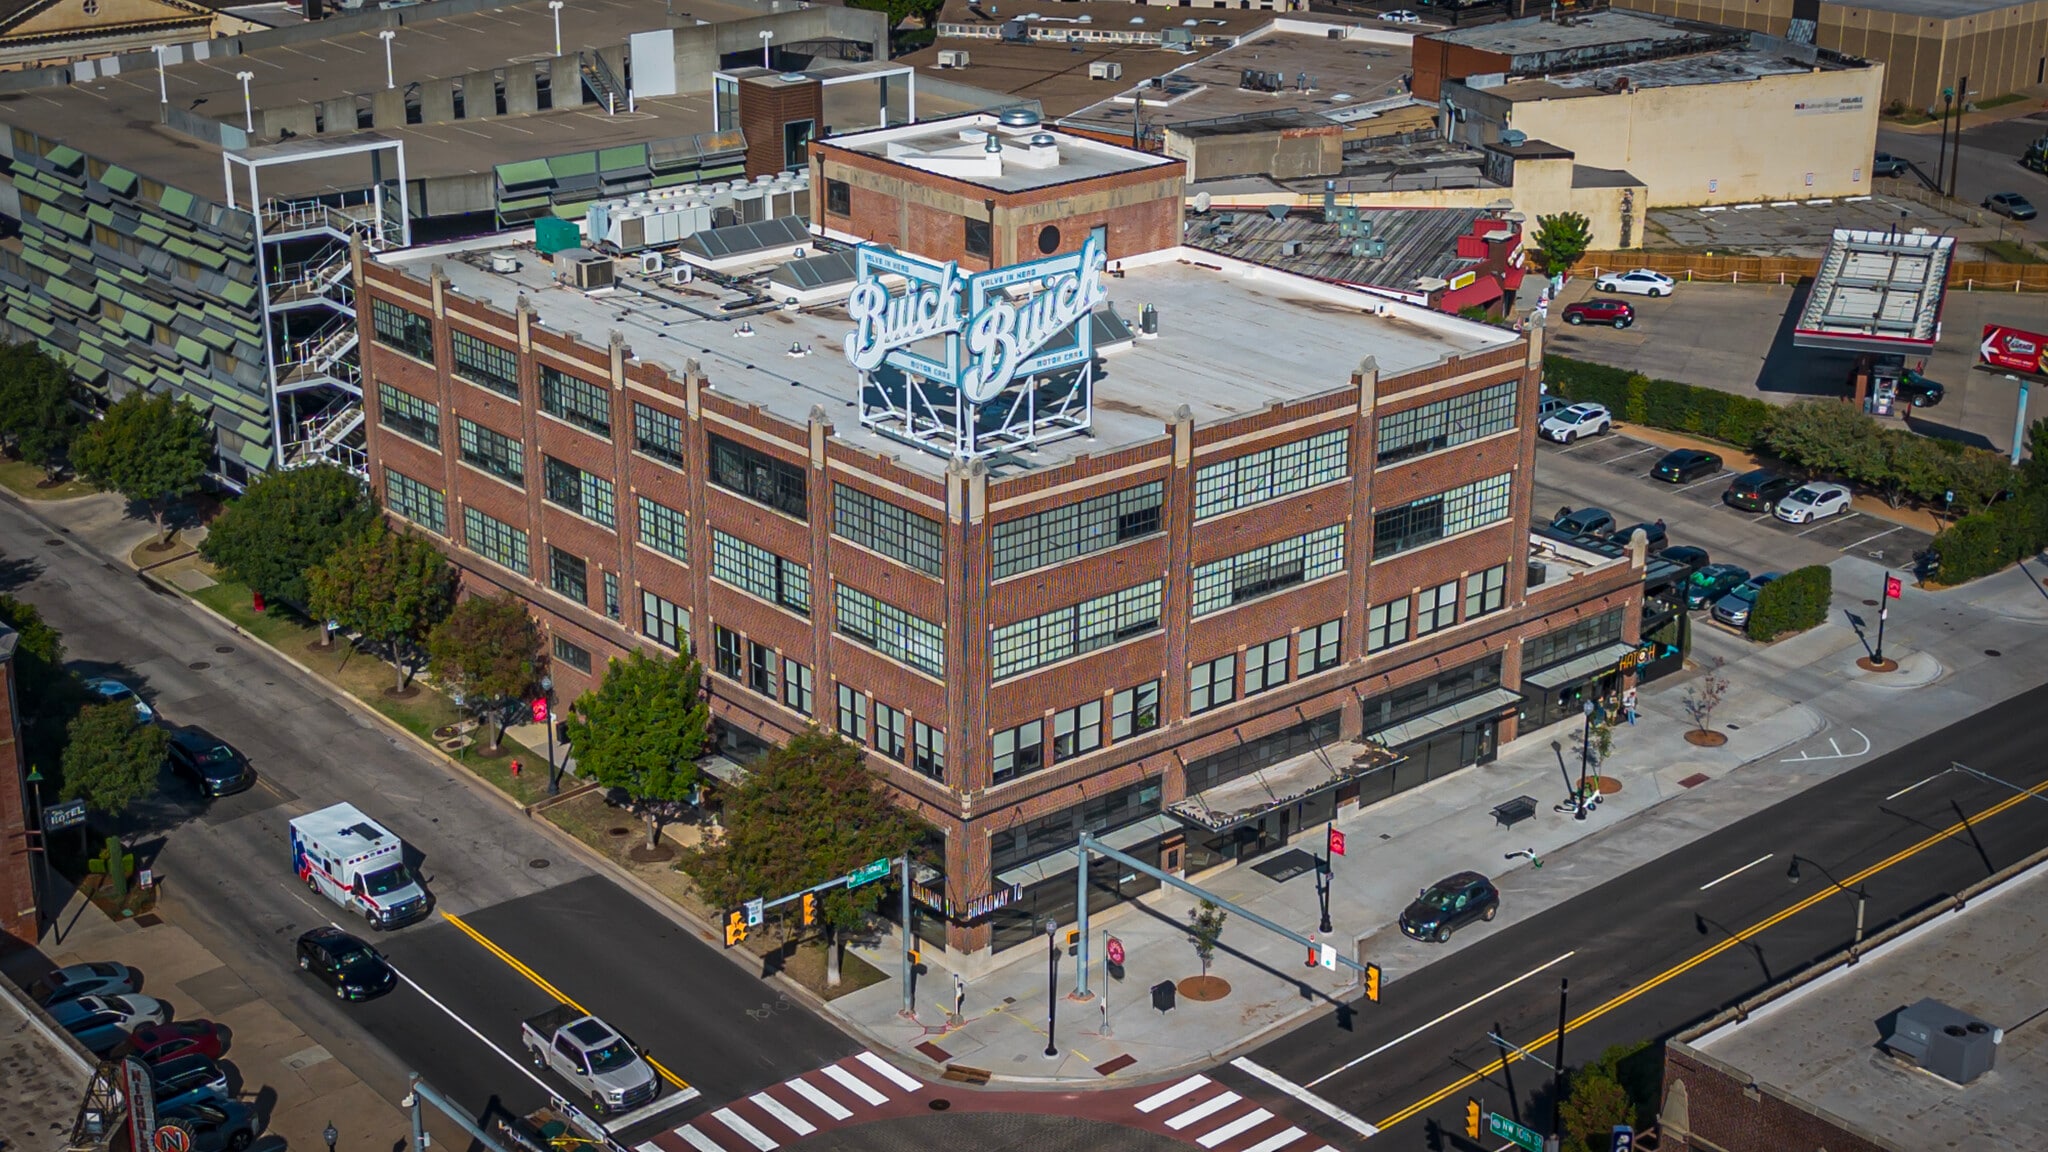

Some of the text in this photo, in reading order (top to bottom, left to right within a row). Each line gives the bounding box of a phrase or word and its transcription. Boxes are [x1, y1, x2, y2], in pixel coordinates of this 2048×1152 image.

[980, 268, 1036, 287] VALVE IN HEAD
[843, 260, 966, 370] Buick
[961, 236, 1108, 403] Buick
[1037, 350, 1083, 367] MOTOR CARS
[910, 360, 951, 380] MOTOR CARS
[1619, 643, 1656, 671] HATCH
[51, 806, 85, 824] HOTEL
[967, 889, 1009, 920] BROADWAY
[161, 1131, 183, 1152] N
[1502, 1120, 1514, 1134] NW
[1516, 1127, 1532, 1143] 10th
